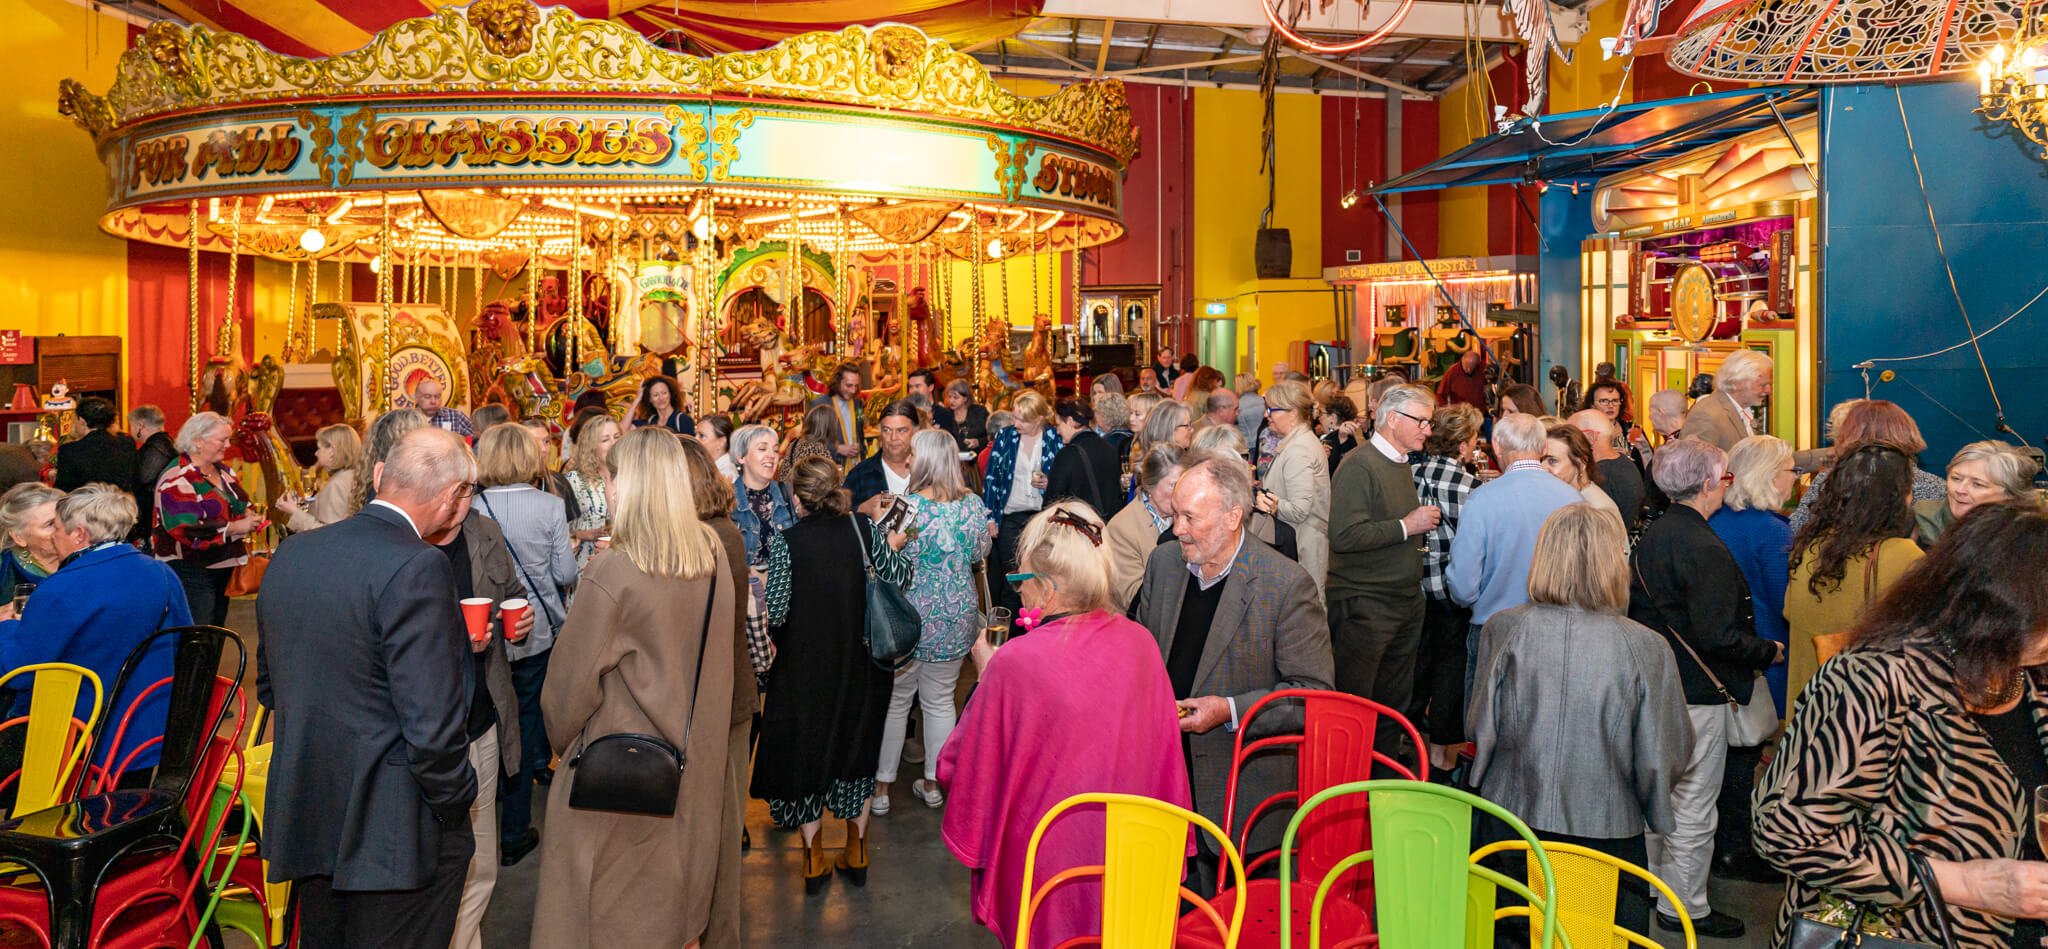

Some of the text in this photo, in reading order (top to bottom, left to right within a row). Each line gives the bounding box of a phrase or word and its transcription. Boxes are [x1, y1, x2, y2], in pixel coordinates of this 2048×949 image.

[131, 124, 303, 190] FOR ALL
[362, 116, 674, 170] CLASSES
[1339, 259, 1478, 279] De Cap ROBOT ORCHESTRA
